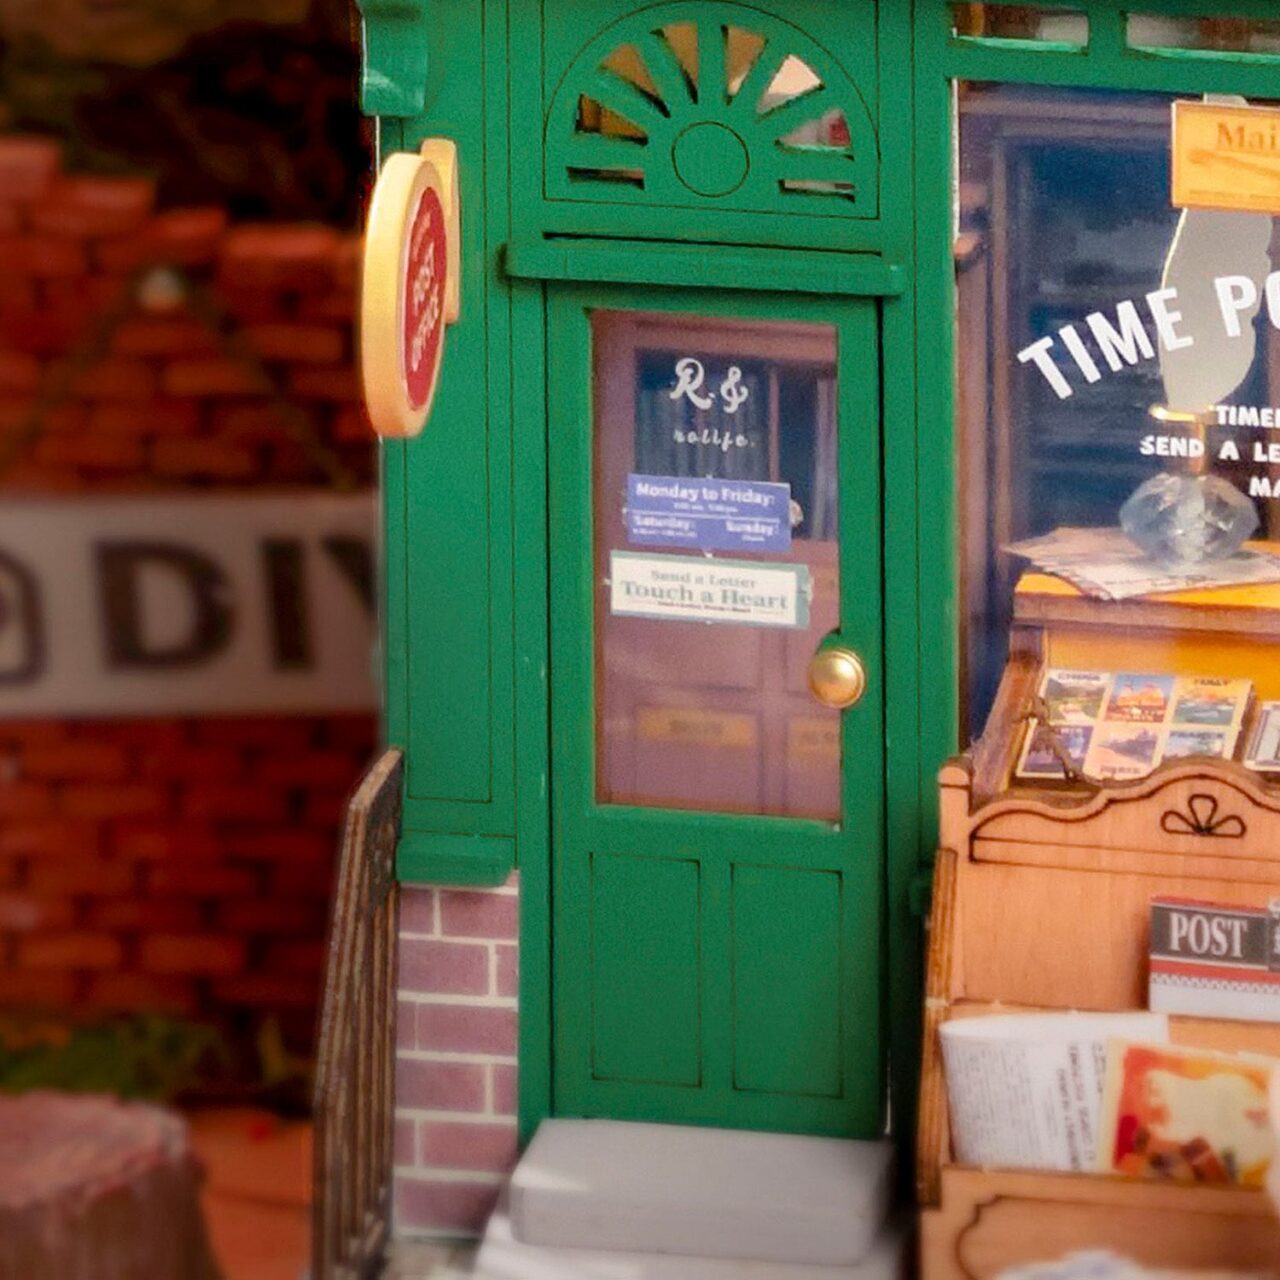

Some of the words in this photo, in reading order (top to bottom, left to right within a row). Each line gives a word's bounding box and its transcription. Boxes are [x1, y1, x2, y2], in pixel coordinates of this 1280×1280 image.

[1017, 286, 1194, 400] TIME
[1140, 435, 1205, 457] SEND
[1218, 440, 1240, 461] A
[635, 483, 700, 502] Monday
[702, 487, 719, 501] to
[651, 569, 691, 584] Send
[621, 580, 694, 602] Touch
[700, 590, 714, 604] a
[720, 587, 788, 610] Heart
[1167, 911, 1248, 959] POST
